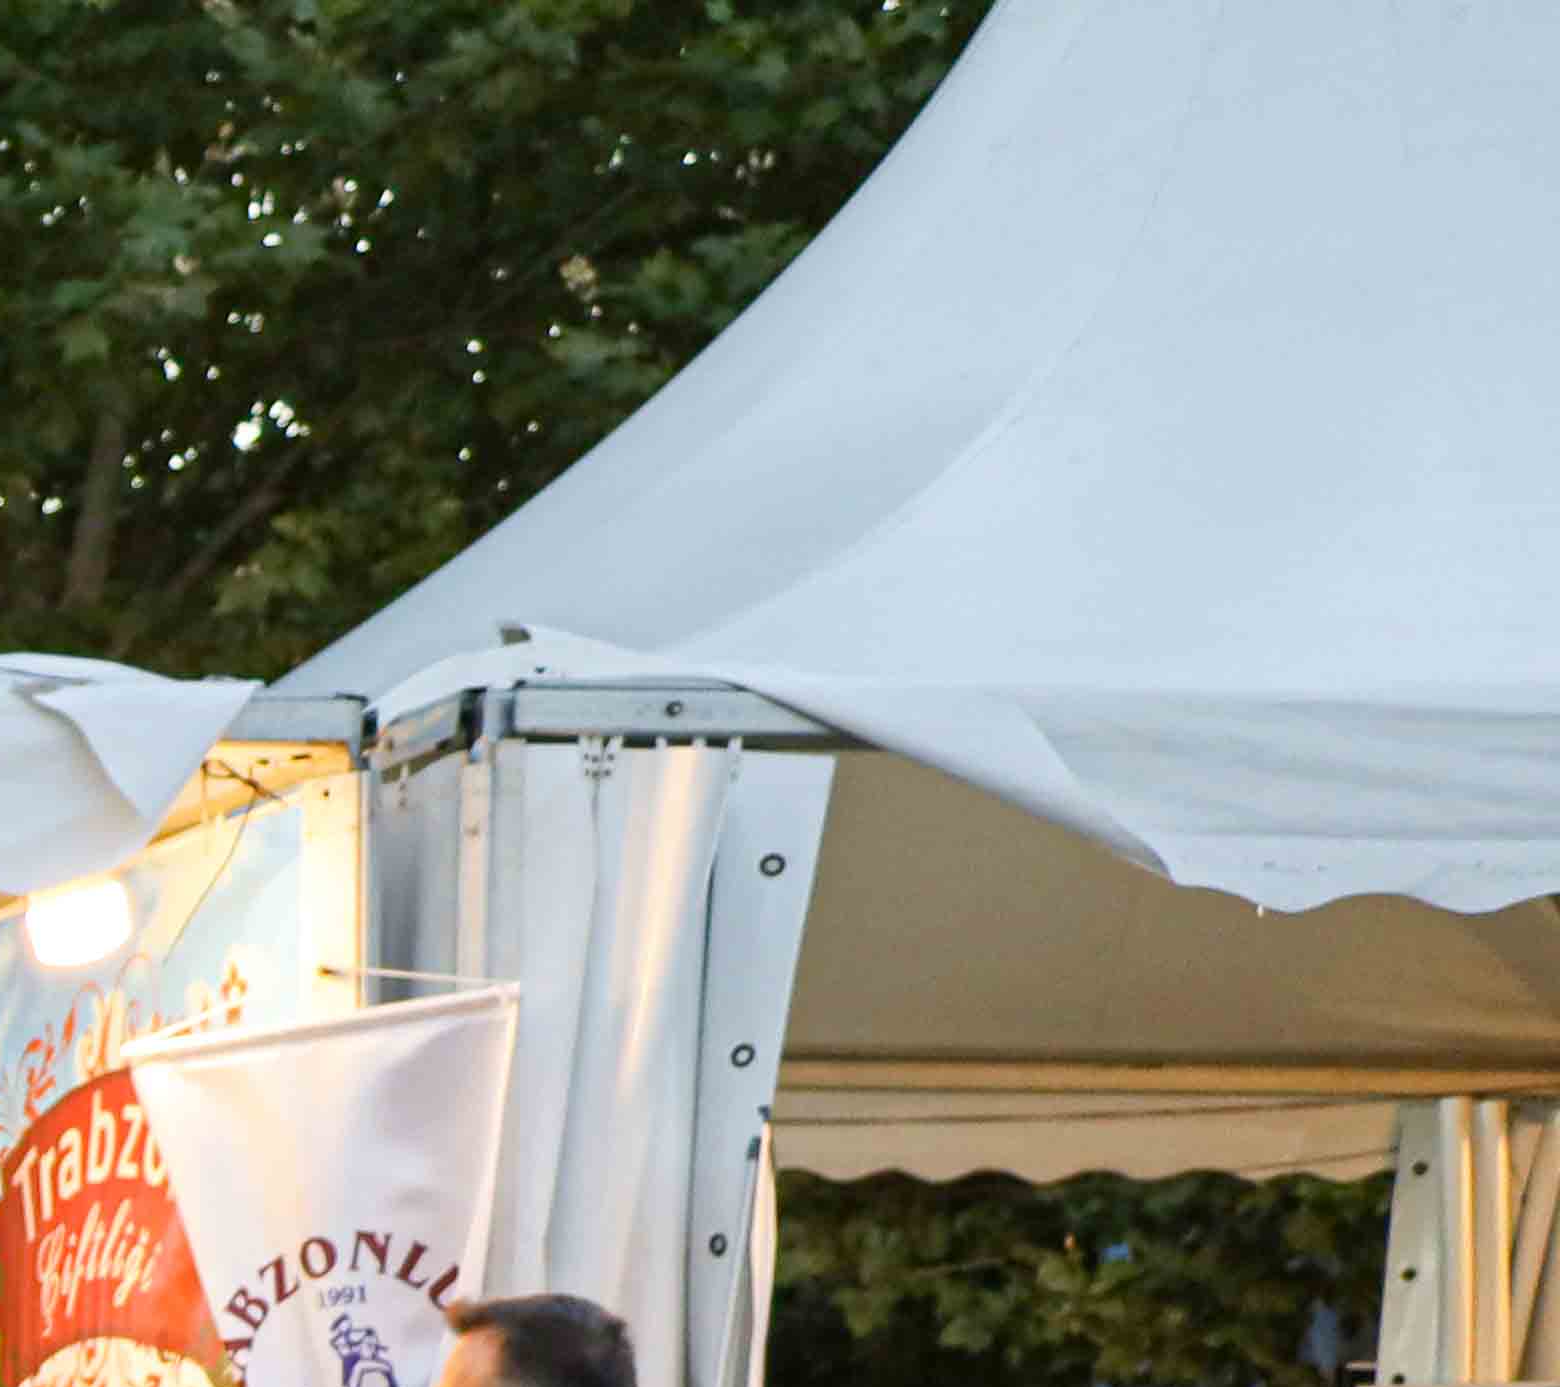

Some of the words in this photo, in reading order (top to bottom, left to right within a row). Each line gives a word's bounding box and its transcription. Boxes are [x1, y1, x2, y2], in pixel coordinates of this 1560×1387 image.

[11, 1088, 169, 1244] Trabzo
[37, 1200, 164, 1337] Çiftliği
[319, 1284, 367, 1308] 1991
